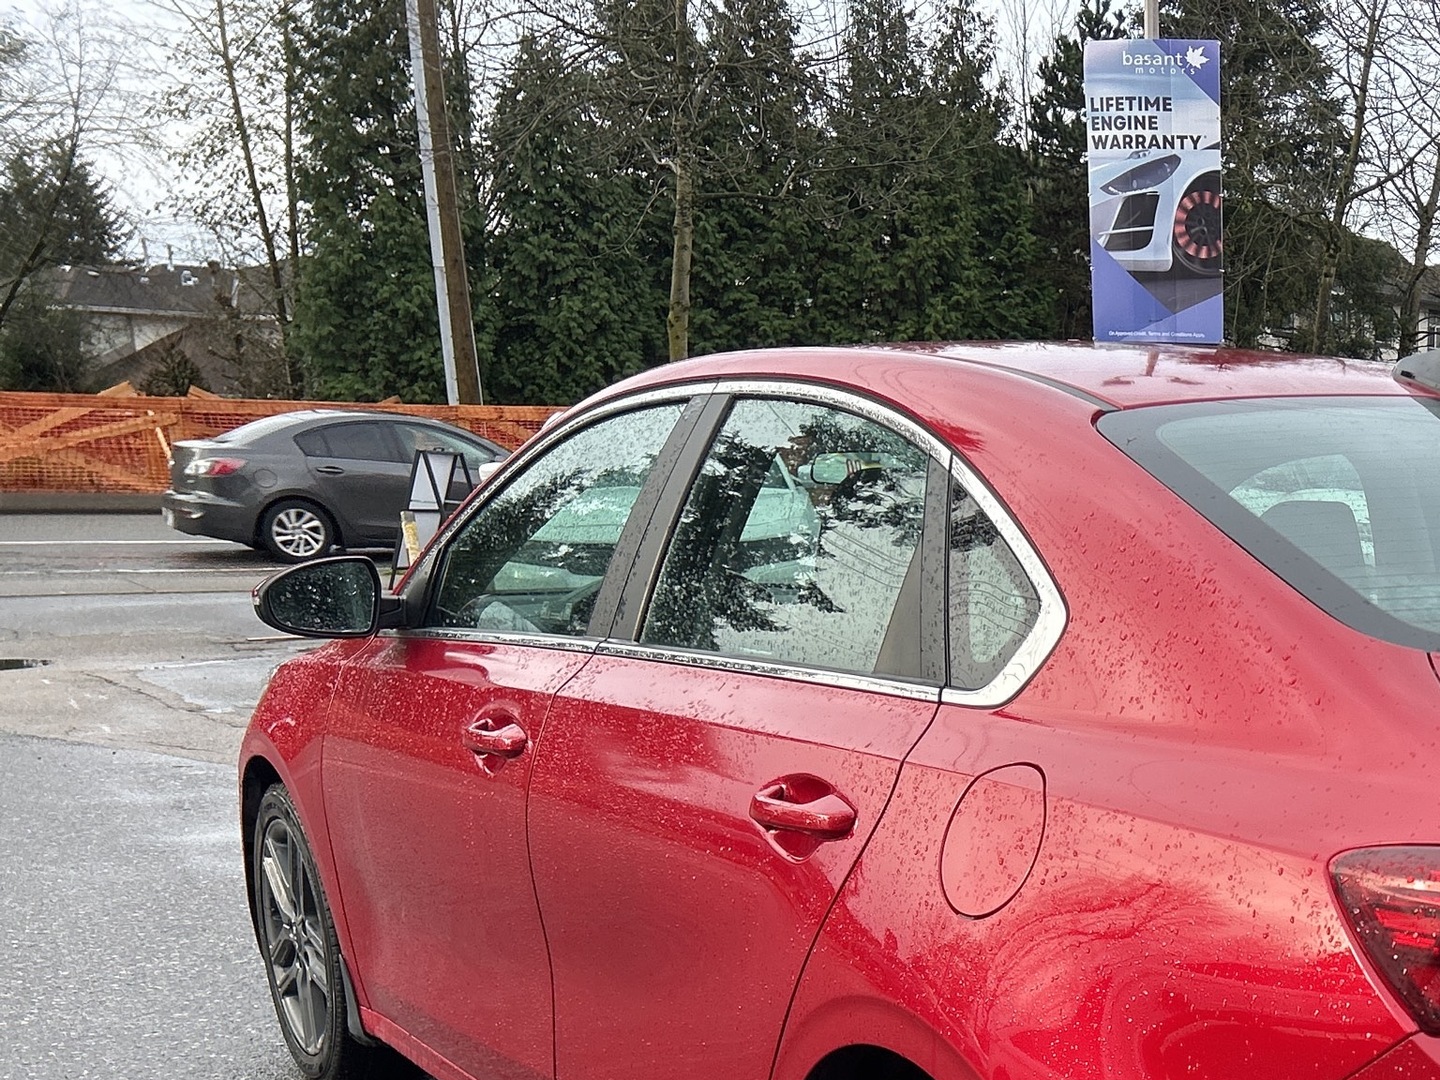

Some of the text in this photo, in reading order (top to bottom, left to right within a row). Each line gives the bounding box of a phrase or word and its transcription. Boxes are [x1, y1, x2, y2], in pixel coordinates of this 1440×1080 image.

[1122, 50, 1183, 66] basant
[1135, 66, 1195, 75] motors
[1090, 96, 1172, 112] LIFETIME
[1091, 115, 1158, 131] ENGINE
